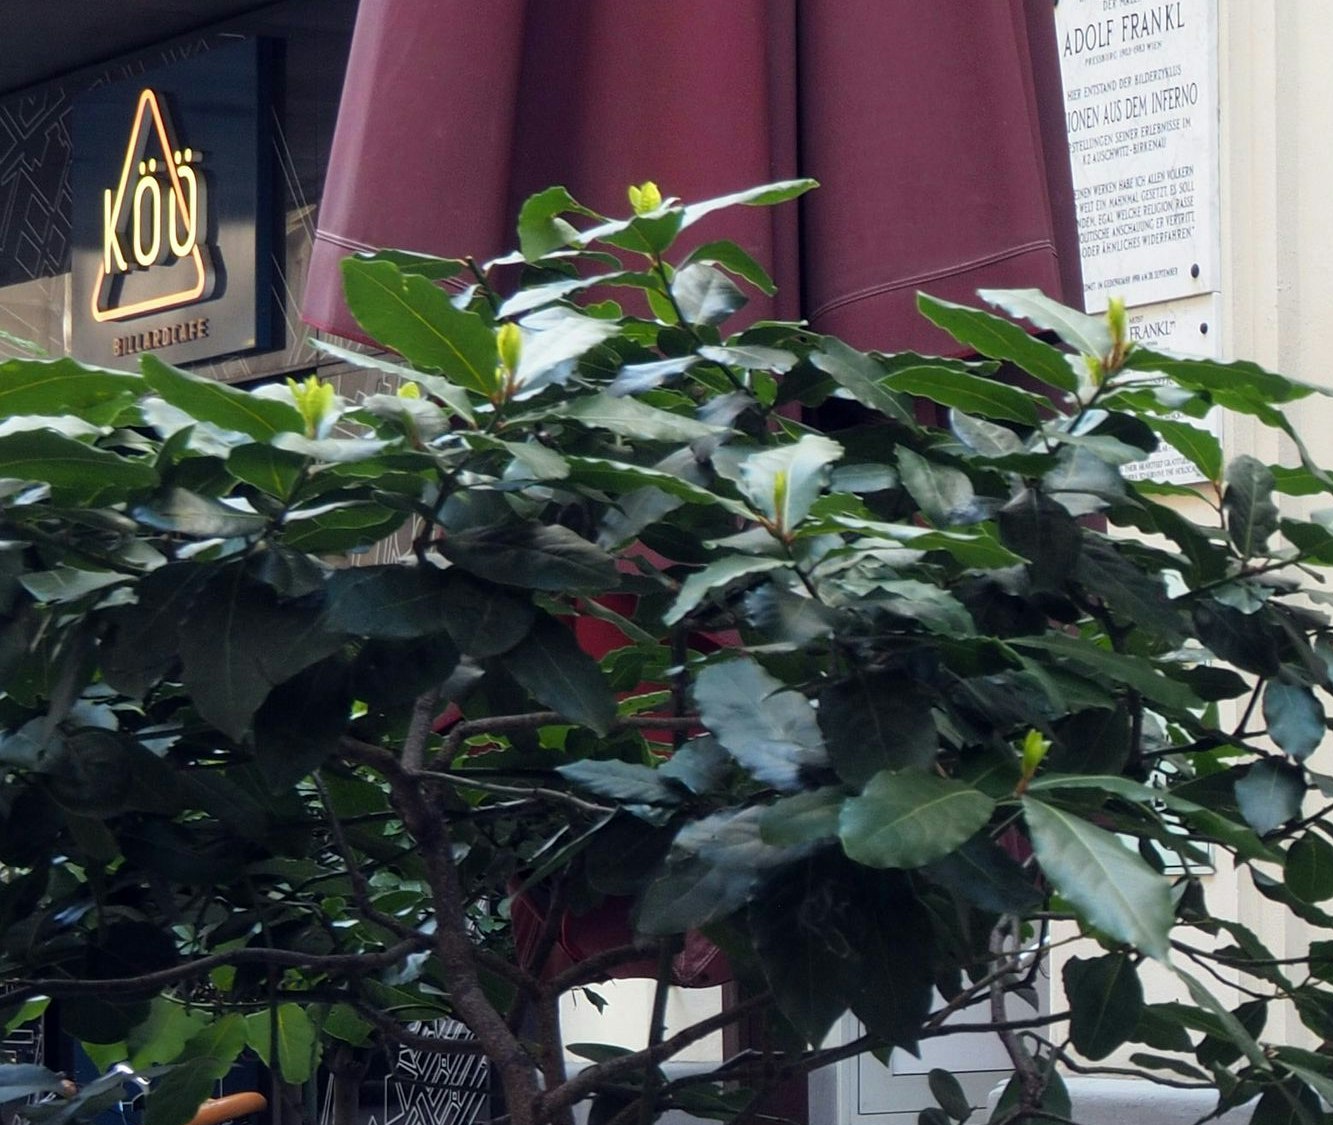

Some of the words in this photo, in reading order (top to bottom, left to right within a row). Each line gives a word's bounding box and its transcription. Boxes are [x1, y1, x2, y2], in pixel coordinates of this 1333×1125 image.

[1064, 19, 1114, 56] ADOLF
[1122, 2, 1184, 42] FRANKL
[1084, 80, 1116, 97] ENTSTAND
[1119, 77, 1131, 88] DER
[1134, 65, 1182, 85] BILDERZYKLUS
[1068, 105, 1099, 132] IONEN
[1102, 100, 1121, 124] AUS
[1125, 94, 1146, 119] DEM
[1151, 83, 1198, 113] INFERNO
[1070, 134, 1112, 153] STELLUNGEN
[1115, 128, 1138, 142] SEINER
[1140, 119, 1180, 137] ERLEBNISSE
[1182, 116, 1191, 128] IM
[1074, 187, 1091, 199] EINEN
[1080, 228, 1109, 243] OLITISCHE
